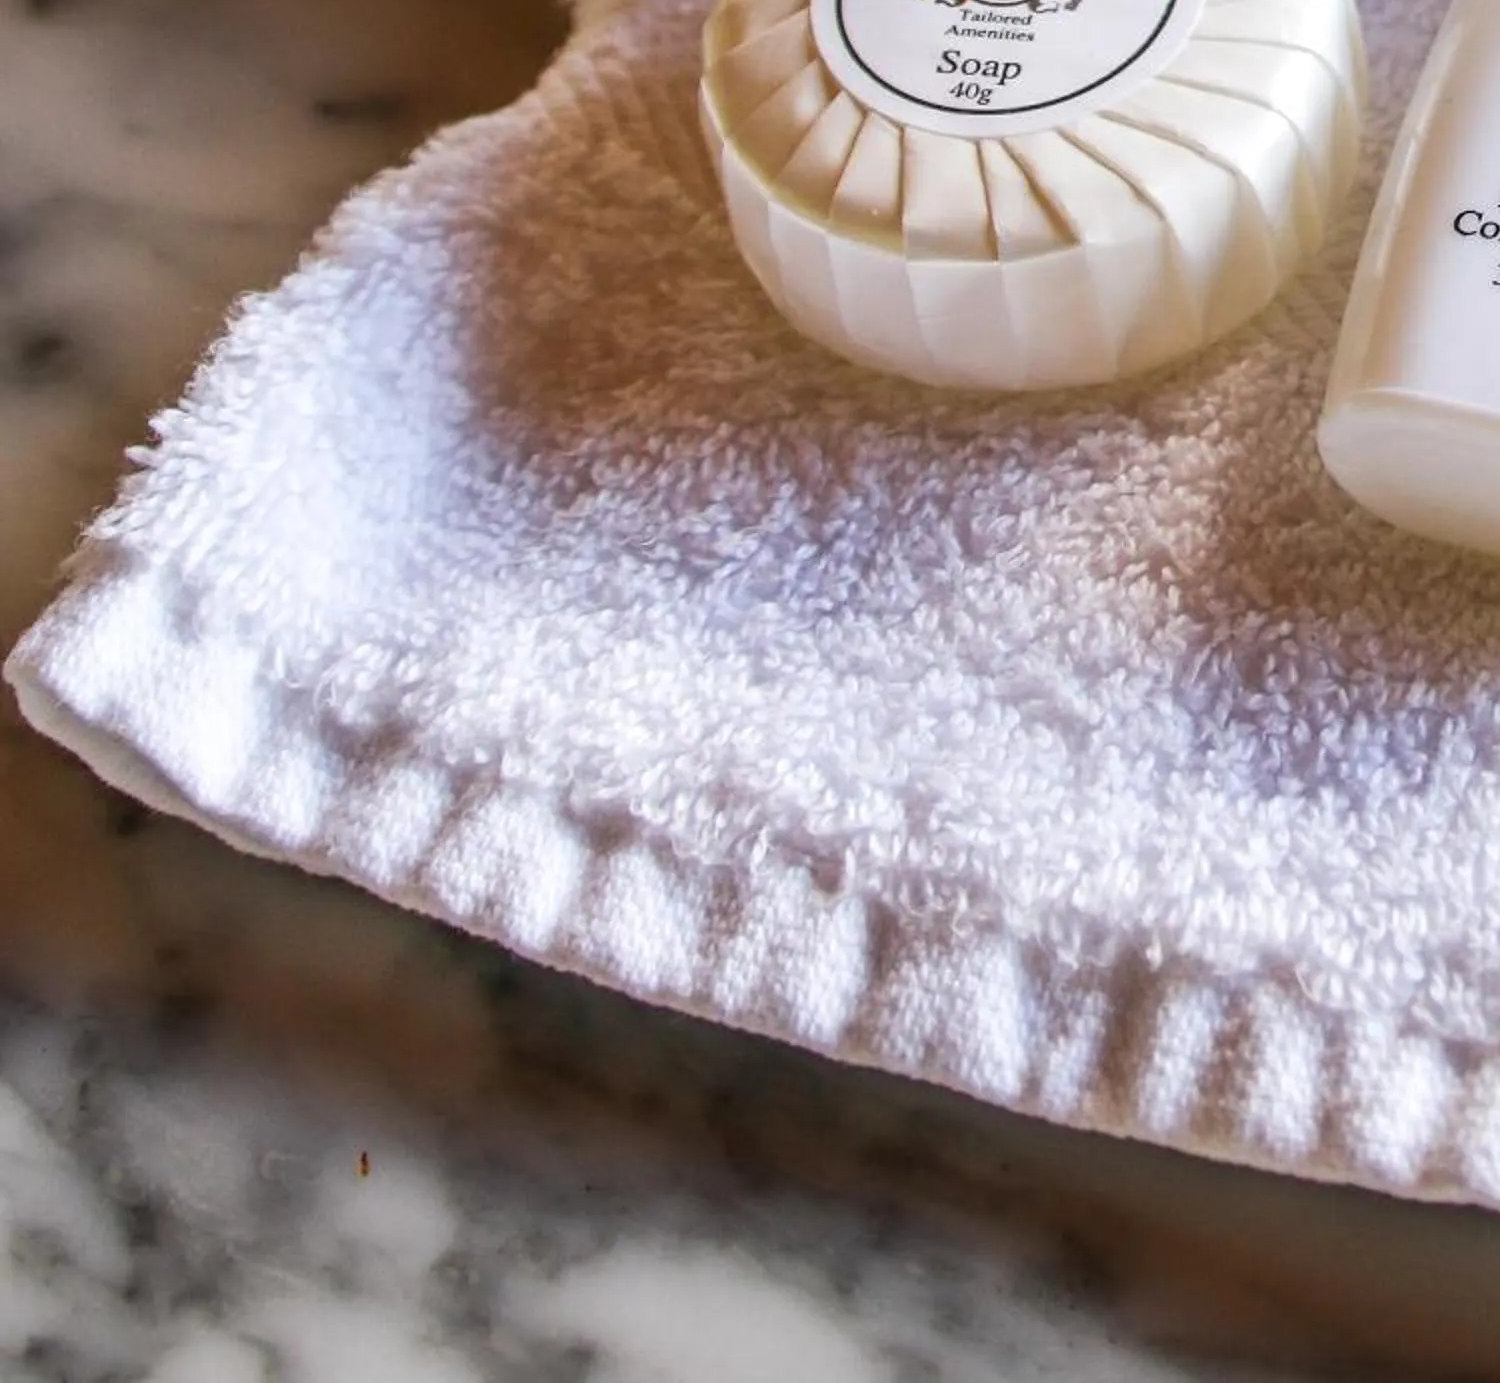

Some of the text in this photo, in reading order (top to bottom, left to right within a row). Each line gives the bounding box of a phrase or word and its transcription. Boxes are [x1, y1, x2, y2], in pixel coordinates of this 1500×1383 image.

[960, 9, 1033, 26] Tailored
[944, 25, 1035, 42] Amenities
[936, 50, 1022, 85] Soap
[949, 82, 993, 105] 40g
